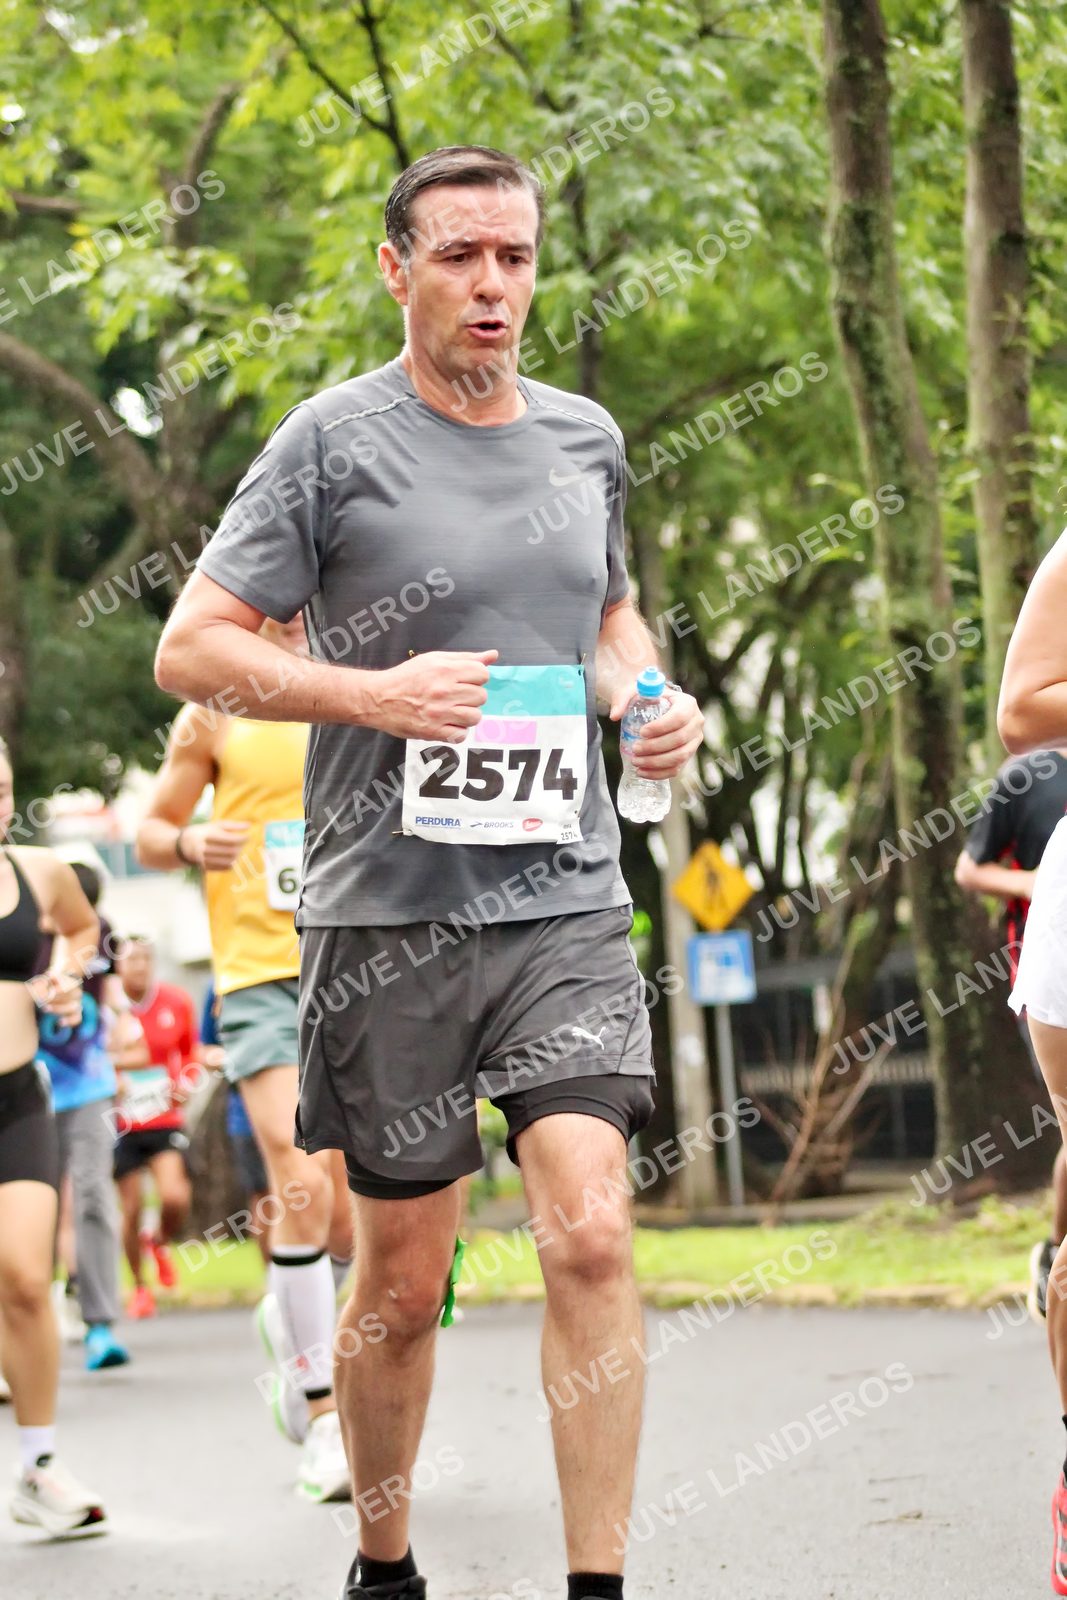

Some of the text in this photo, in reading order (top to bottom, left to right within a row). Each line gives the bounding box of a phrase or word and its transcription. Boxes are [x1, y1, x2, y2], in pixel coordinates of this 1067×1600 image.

[419, 745, 578, 802] 2574
[415, 816, 461, 827] PERDURA
[483, 821, 514, 829] BROOKS
[278, 867, 297, 894] 6
